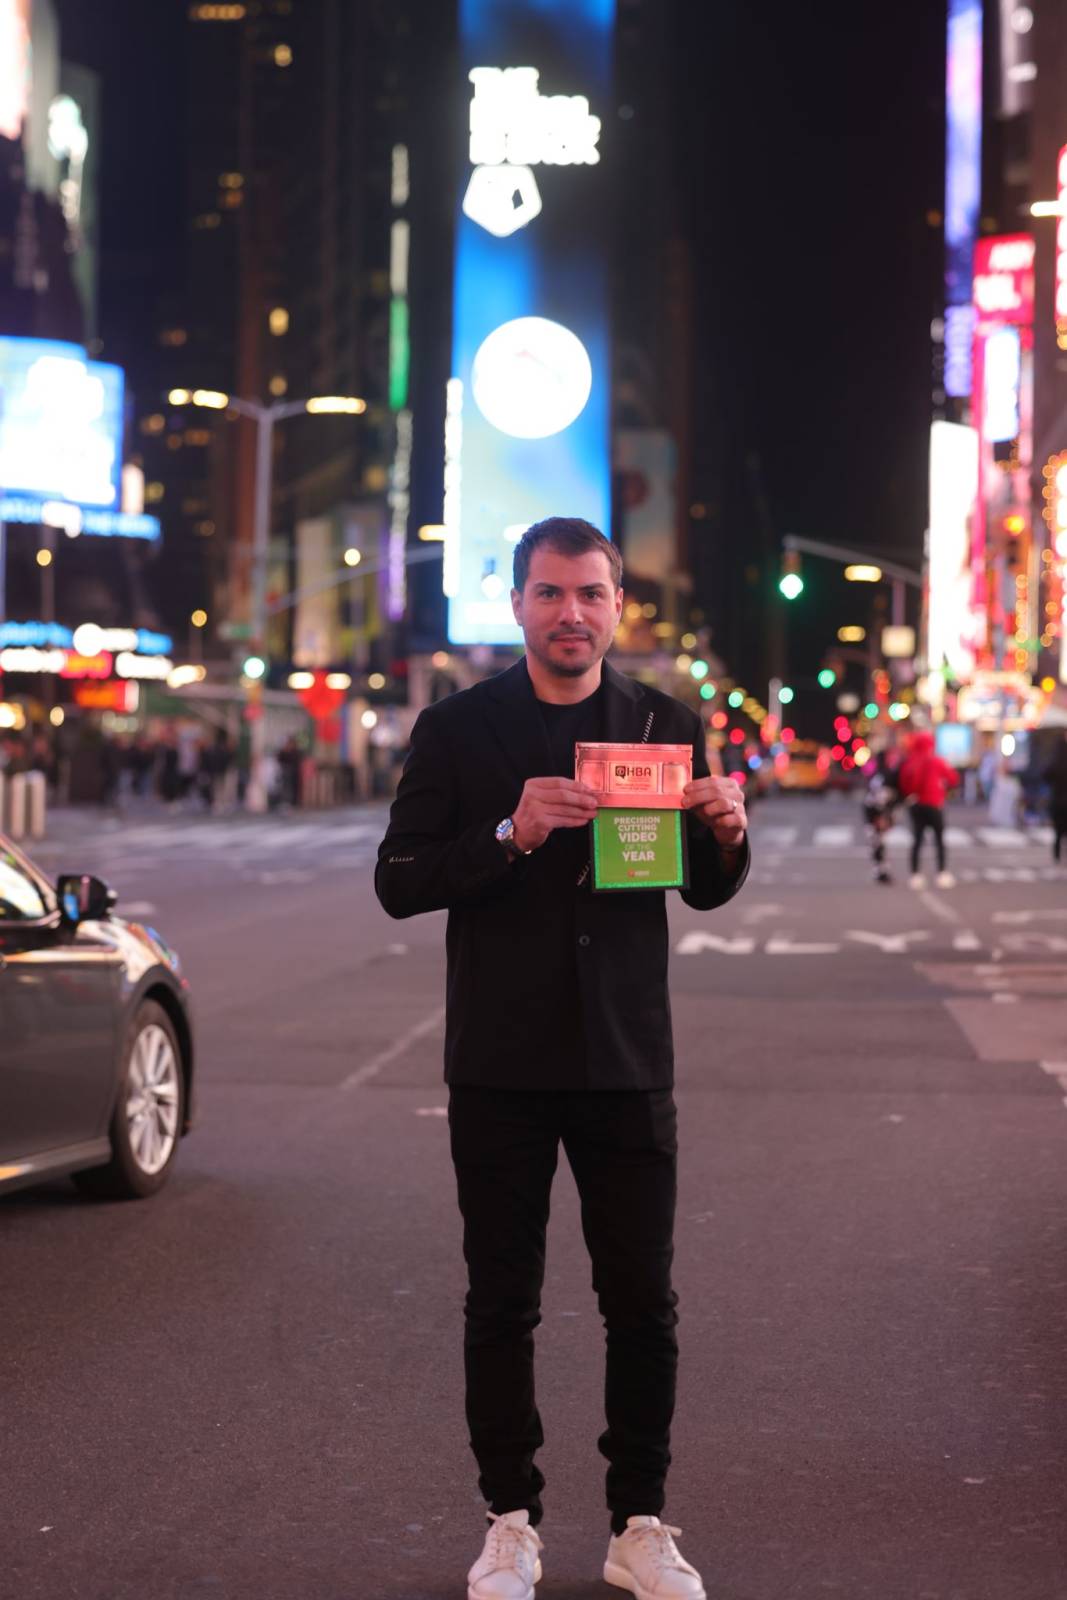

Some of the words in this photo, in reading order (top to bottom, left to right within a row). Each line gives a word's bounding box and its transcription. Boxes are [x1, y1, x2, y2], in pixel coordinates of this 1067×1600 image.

[614, 816, 660, 825] PRECISION
[617, 824, 657, 832] CUTTING
[618, 832, 657, 842] VIDEO
[622, 851, 656, 862] YEAR
[675, 929, 932, 954] NLY
